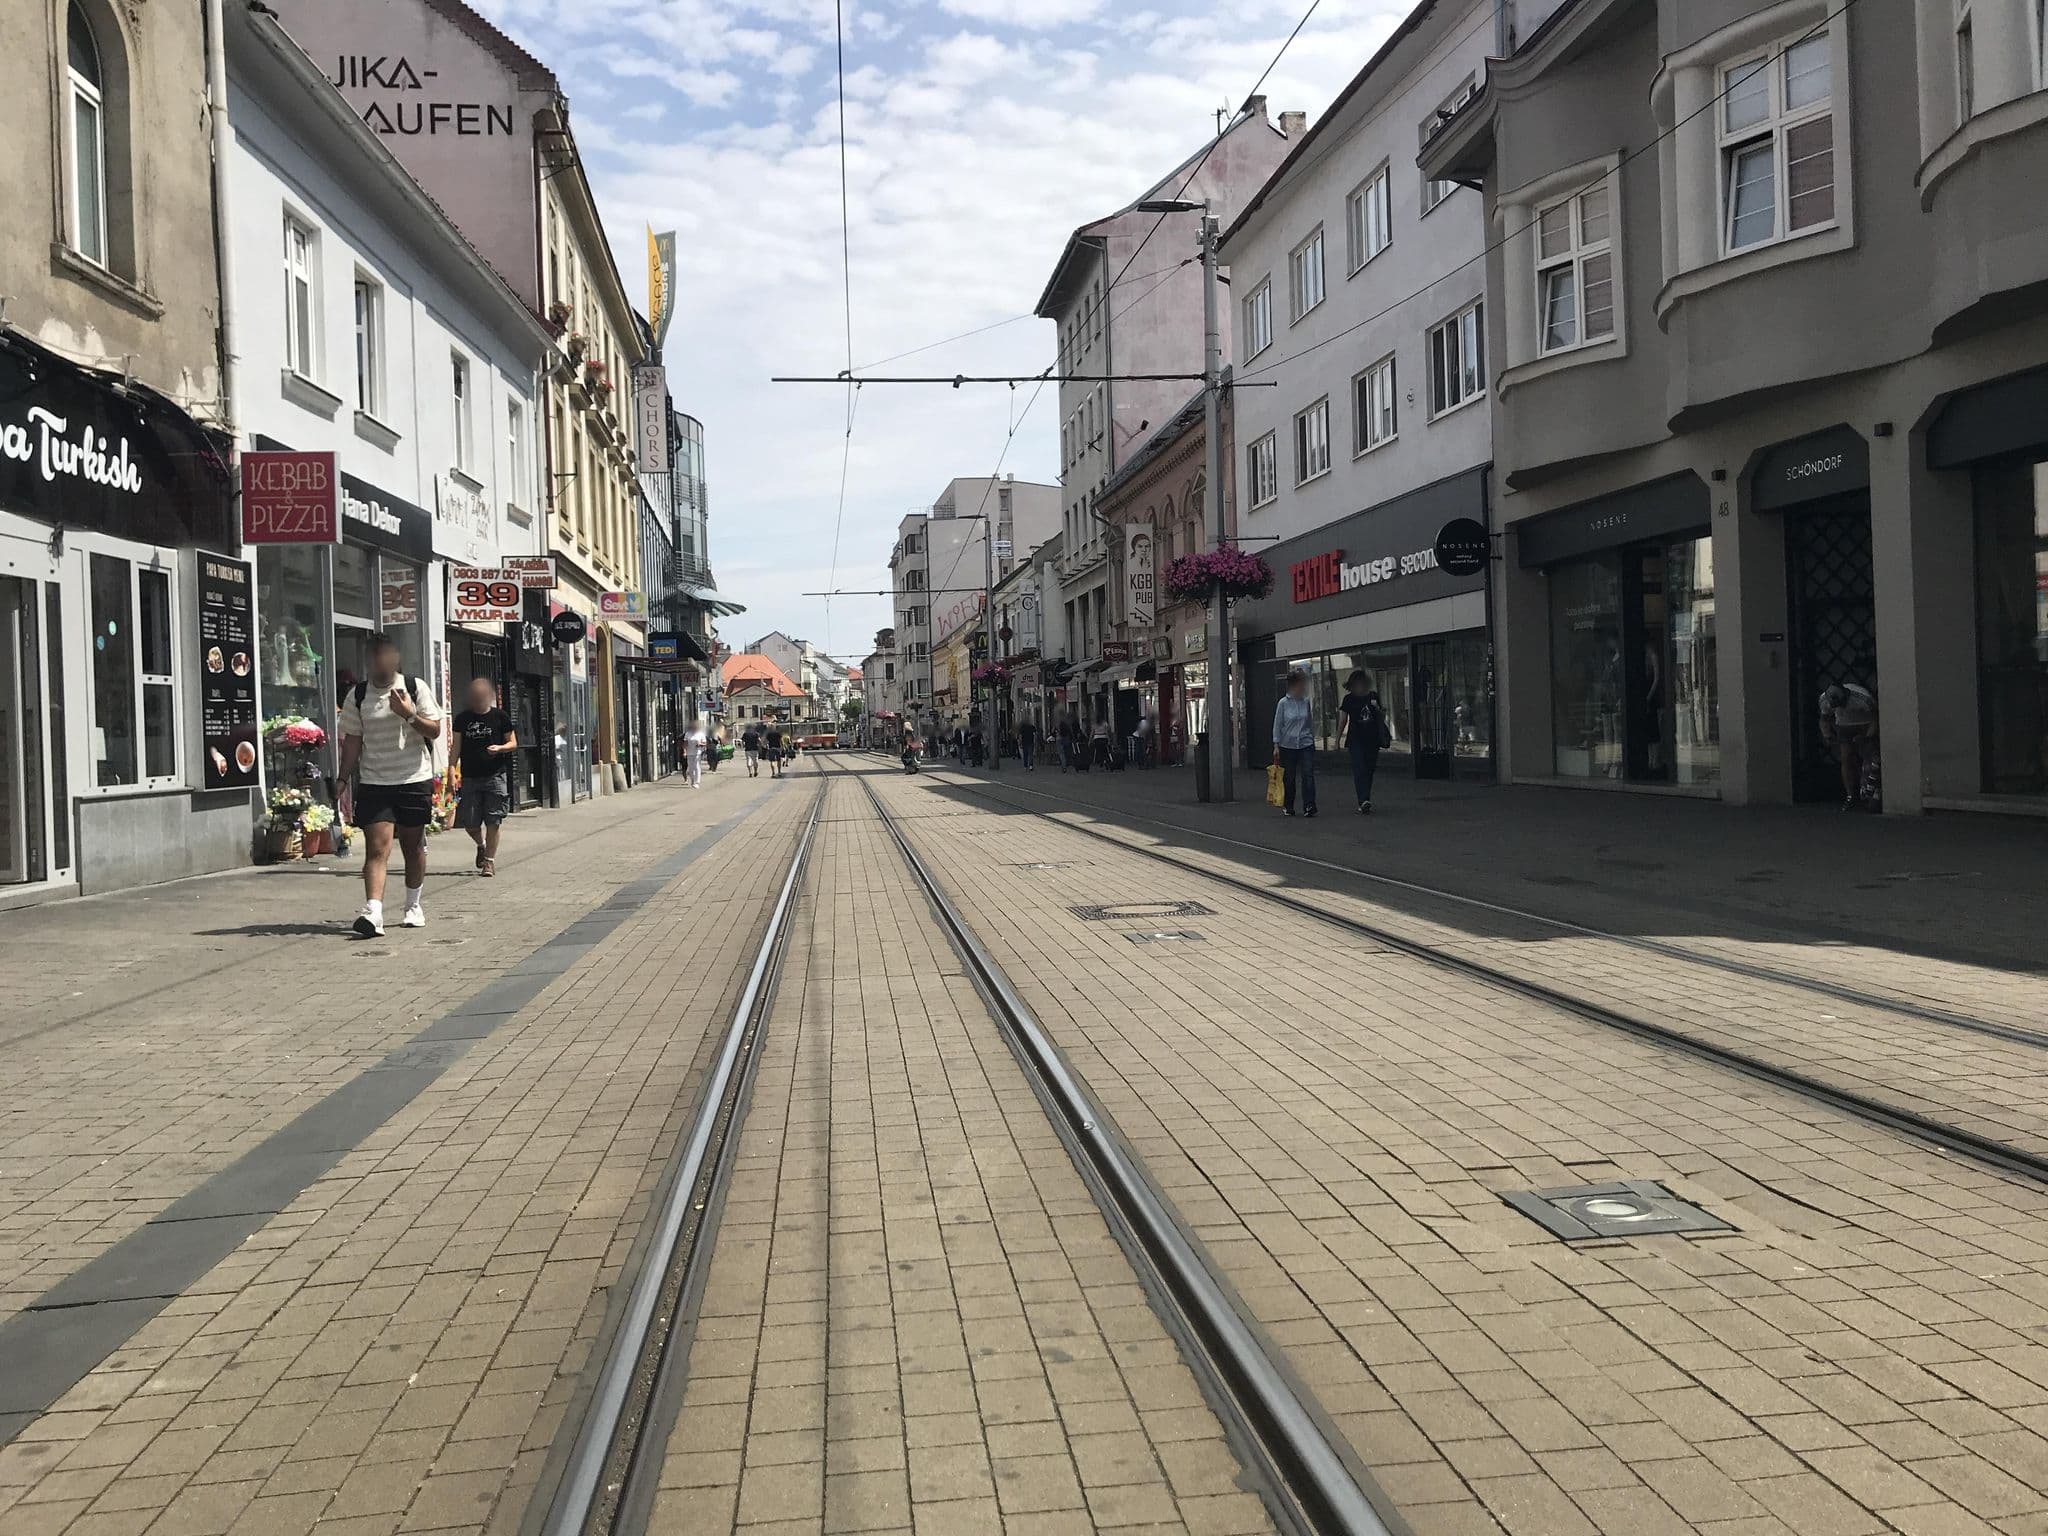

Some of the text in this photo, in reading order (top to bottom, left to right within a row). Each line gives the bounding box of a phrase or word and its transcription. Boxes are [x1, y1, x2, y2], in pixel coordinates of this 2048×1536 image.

[362, 102, 513, 135] AUFEN
[28, 406, 142, 493] Turkish
[250, 461, 327, 491] KEBAB
[1786, 454, 1842, 481] SCHÖNDORF
[251, 504, 329, 534] PIZZA
[1129, 573, 1153, 590] KGB
[1289, 548, 1439, 604] TEXTILE house secon
[457, 581, 519, 607] 39
[1135, 591, 1153, 604] PUB
